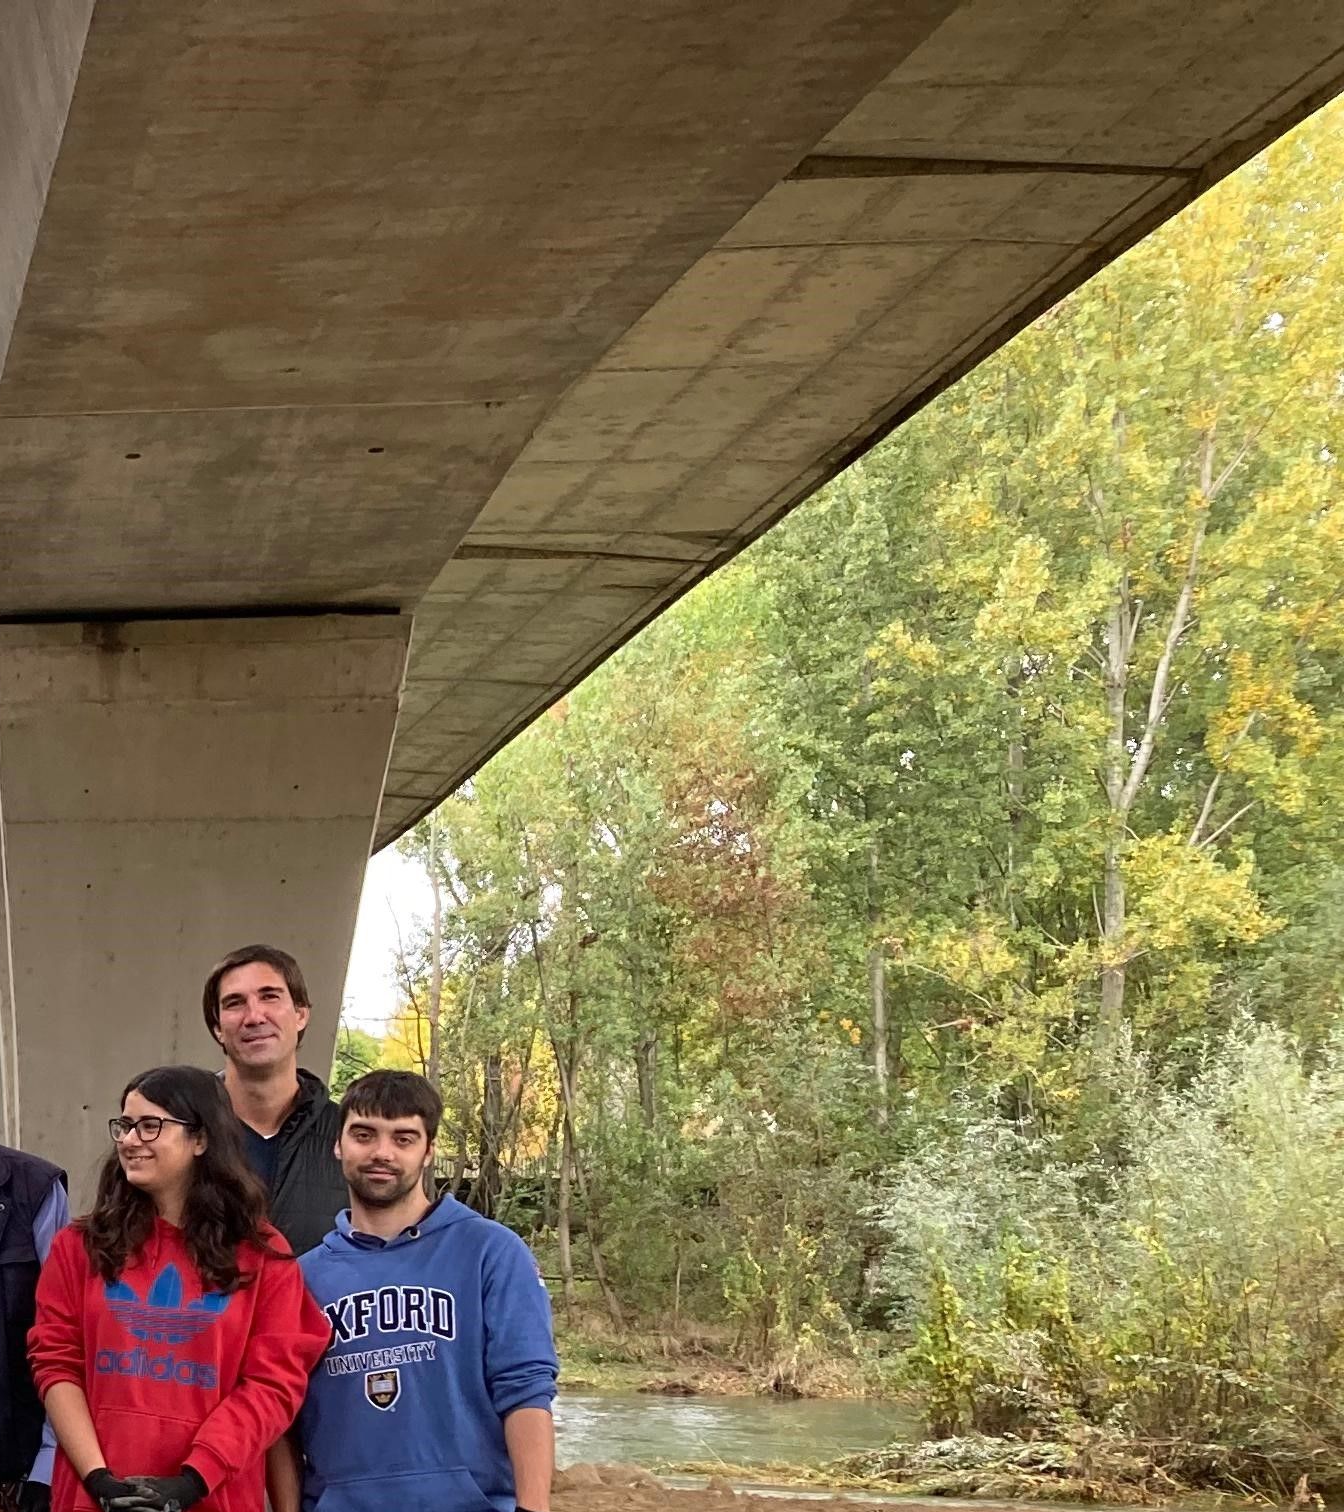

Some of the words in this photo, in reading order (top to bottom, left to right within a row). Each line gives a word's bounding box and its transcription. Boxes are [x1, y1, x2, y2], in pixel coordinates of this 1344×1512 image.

[320, 1285, 456, 1351] XFORD
[96, 1346, 217, 1390] adidas
[325, 1341, 435, 1376] UNIVERSITY
